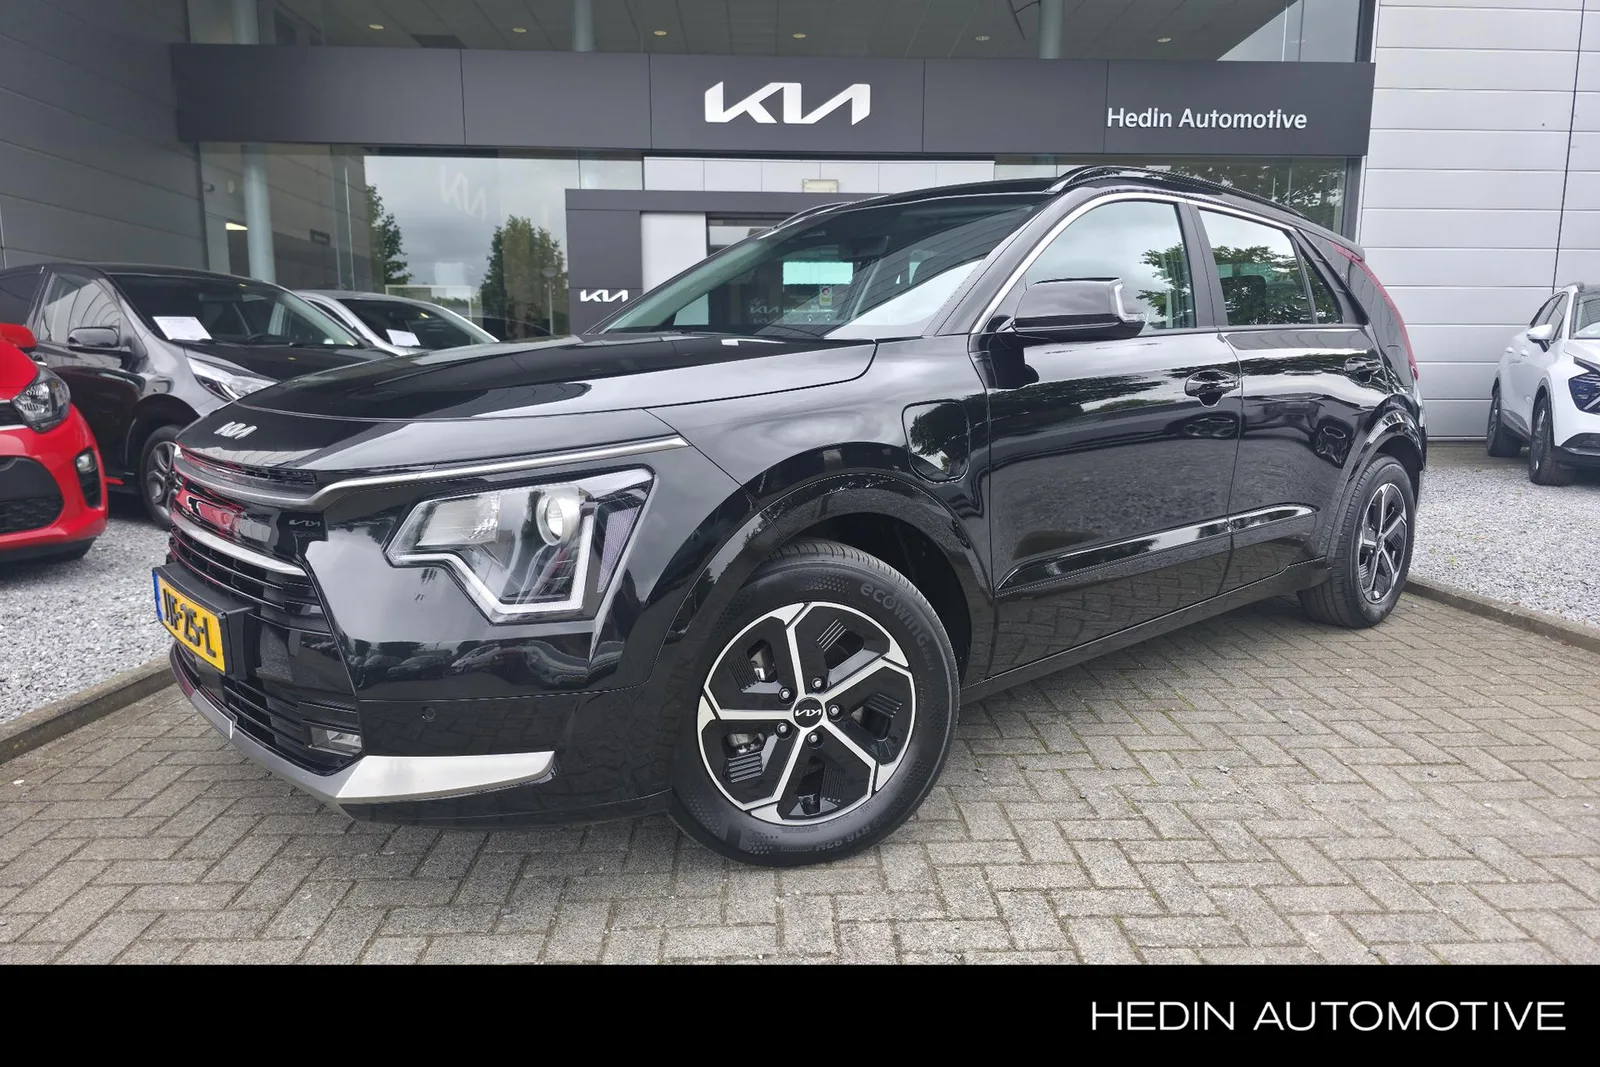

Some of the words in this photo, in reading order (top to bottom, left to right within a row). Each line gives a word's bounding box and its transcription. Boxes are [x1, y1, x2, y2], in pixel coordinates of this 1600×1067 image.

[704, 81, 871, 126] KIA
[1107, 107, 1173, 128] Hedin
[1178, 108, 1308, 129] Automotive
[580, 289, 629, 303] KIA
